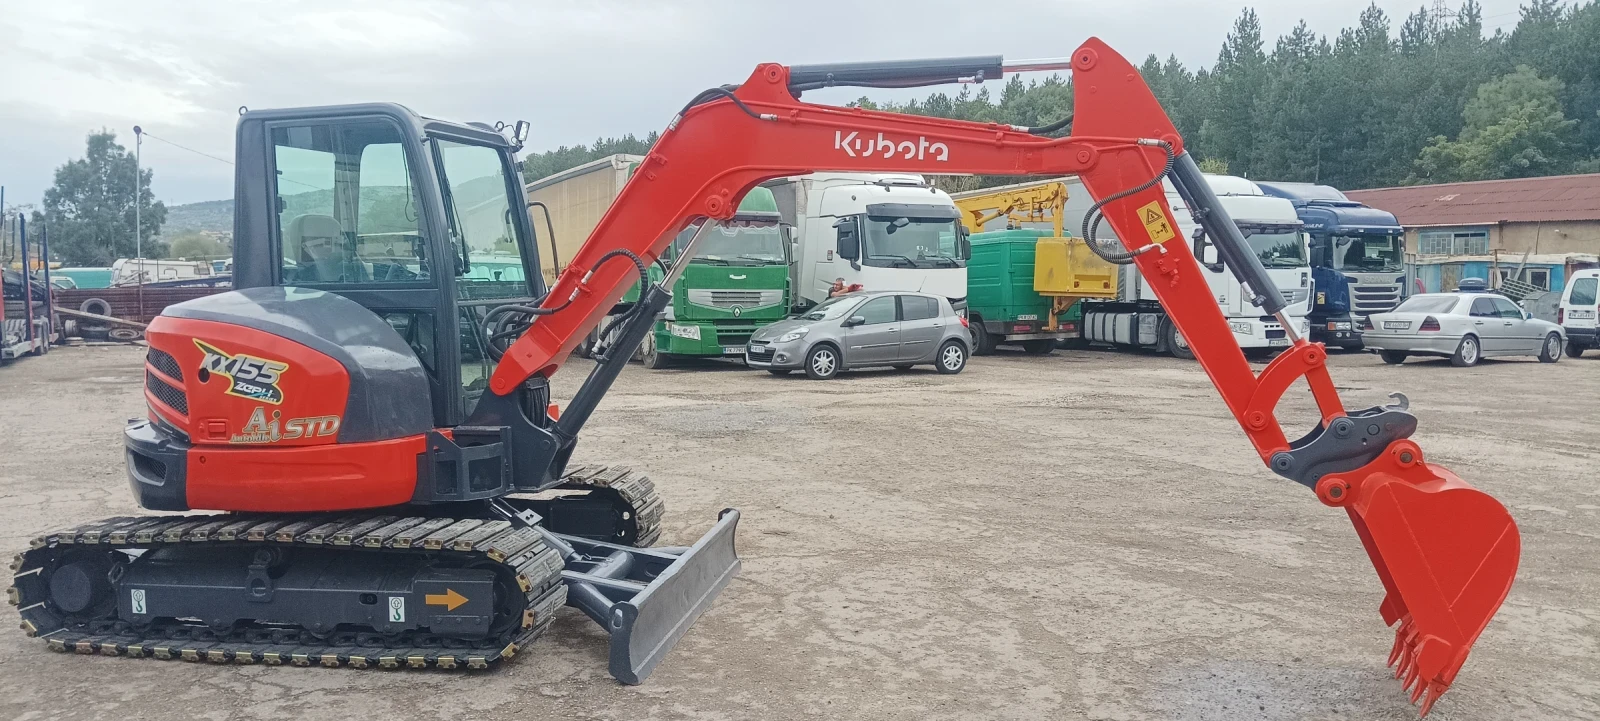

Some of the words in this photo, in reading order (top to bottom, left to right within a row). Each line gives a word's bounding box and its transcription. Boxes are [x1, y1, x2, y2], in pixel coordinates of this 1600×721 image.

[834, 130, 949, 161] Kubota
[1364, 275, 1391, 283] SCANIA
[201, 353, 286, 384] KX155
[283, 415, 340, 439] STD
